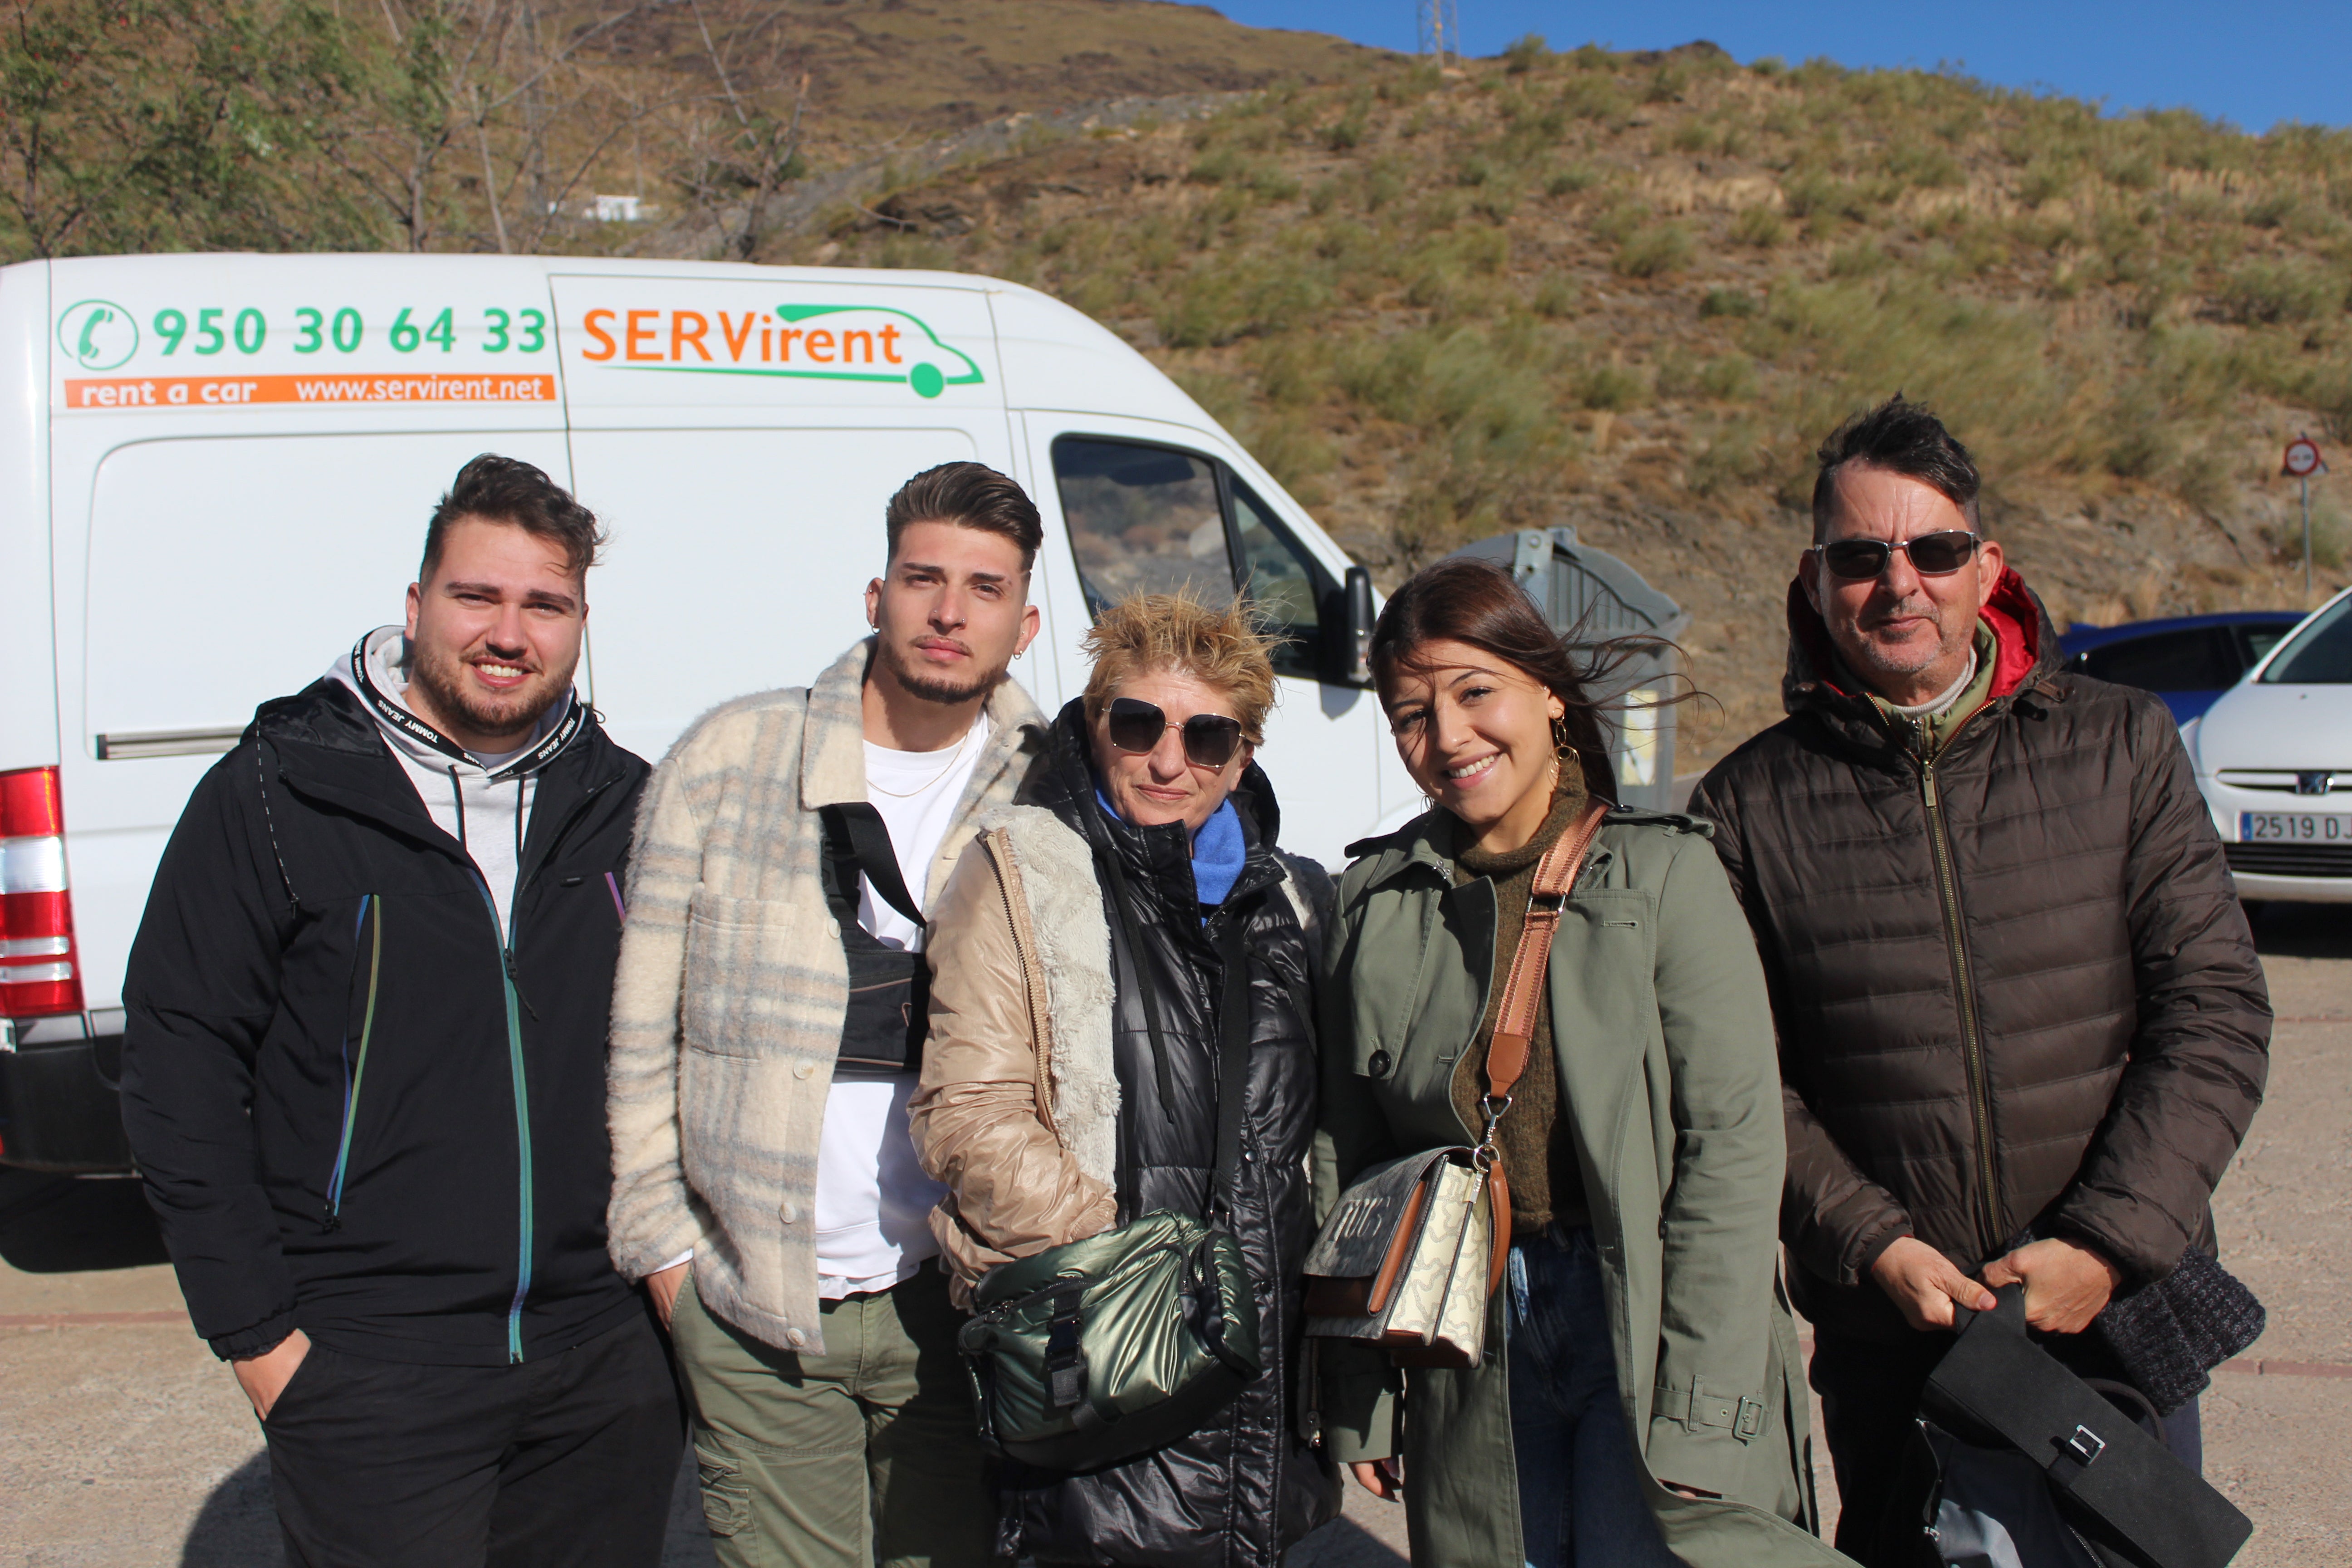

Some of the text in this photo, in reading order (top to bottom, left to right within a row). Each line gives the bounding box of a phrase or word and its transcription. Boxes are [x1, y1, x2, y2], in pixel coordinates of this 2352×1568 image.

[153, 307, 545, 355] 950 30 64 33
[582, 309, 903, 364] SERVirent
[82, 381, 257, 406] rent a car
[295, 374, 544, 401] www.servirent.net
[377, 699, 438, 744] TOMMY JEANS
[538, 717, 576, 760] TOMMY JEANS
[2254, 817, 2315, 838] 2519
